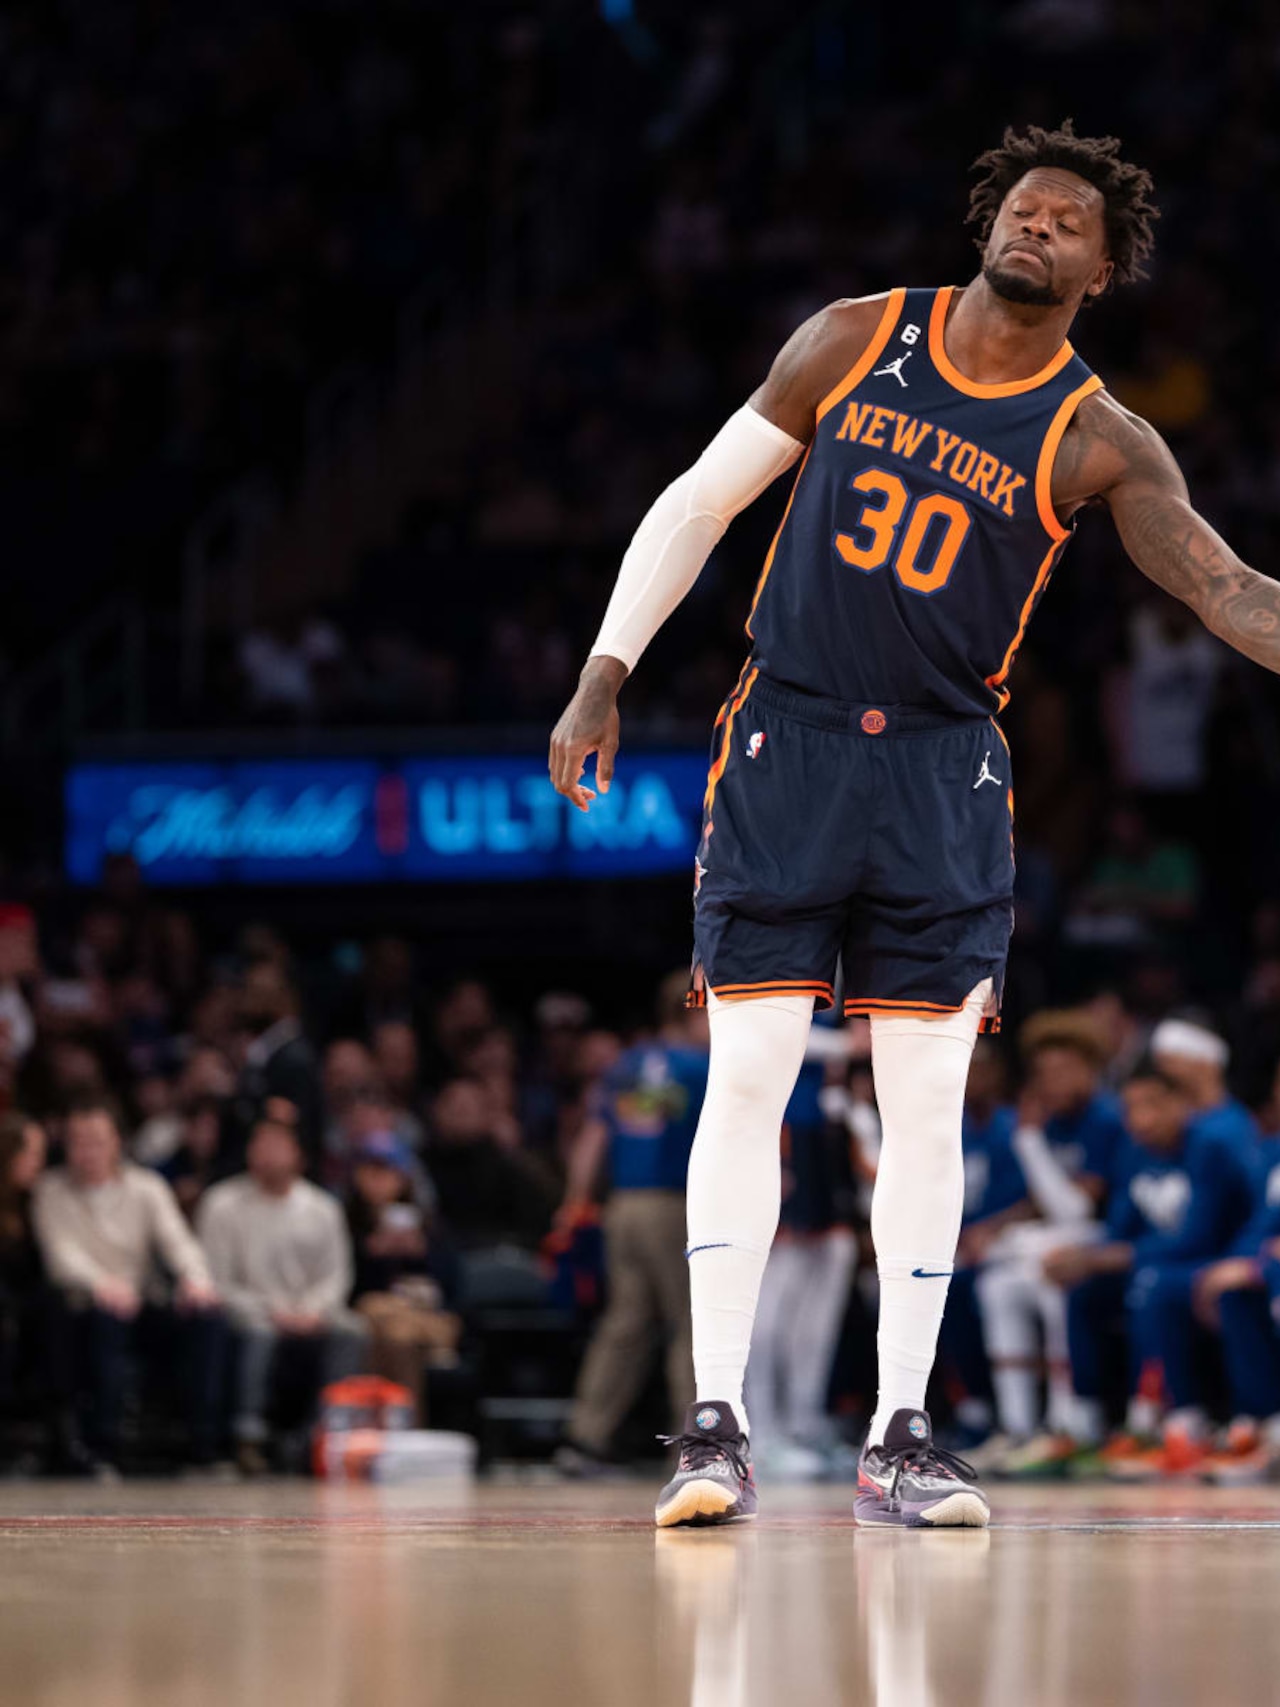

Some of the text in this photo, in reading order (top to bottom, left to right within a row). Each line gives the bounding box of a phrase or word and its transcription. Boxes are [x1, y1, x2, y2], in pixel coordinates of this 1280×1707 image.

[900, 323, 922, 345] 6
[835, 401, 1027, 517] NEW YORK
[832, 465, 974, 597] 30
[418, 771, 684, 855] ULTRA
